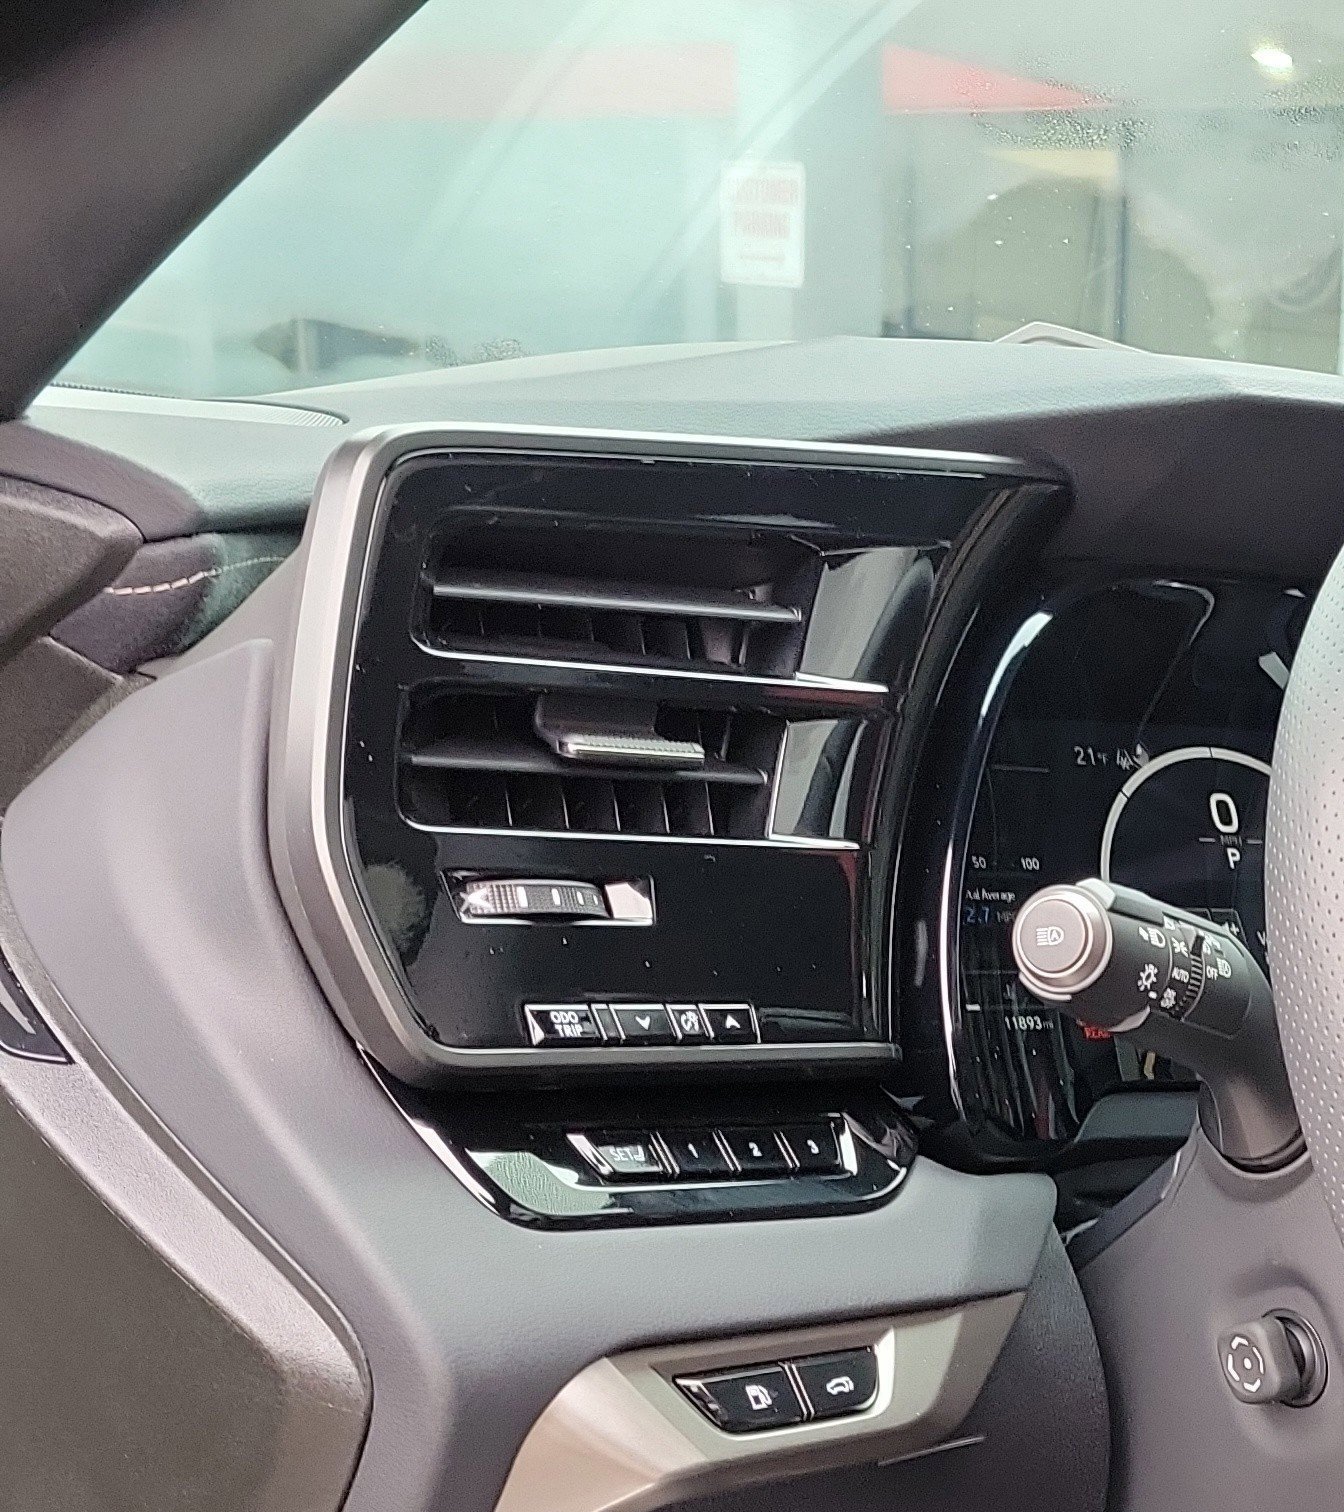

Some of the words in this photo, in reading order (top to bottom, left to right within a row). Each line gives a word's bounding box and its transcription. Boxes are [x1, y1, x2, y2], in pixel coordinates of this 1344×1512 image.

[1209, 792, 1239, 834] 0
[971, 855, 987, 869] 50
[1020, 856, 1041, 871] 100
[1226, 847, 1241, 869] P
[1172, 966, 1190, 983] AUTO
[1206, 965, 1218, 981] OFF
[550, 1011, 579, 1024] ODO
[1004, 1016, 1042, 1030] 11893
[554, 1024, 583, 1037] TRIP
[610, 1148, 633, 1161] SET
[749, 1142, 762, 1157] 2
[806, 1139, 819, 1154] 3
